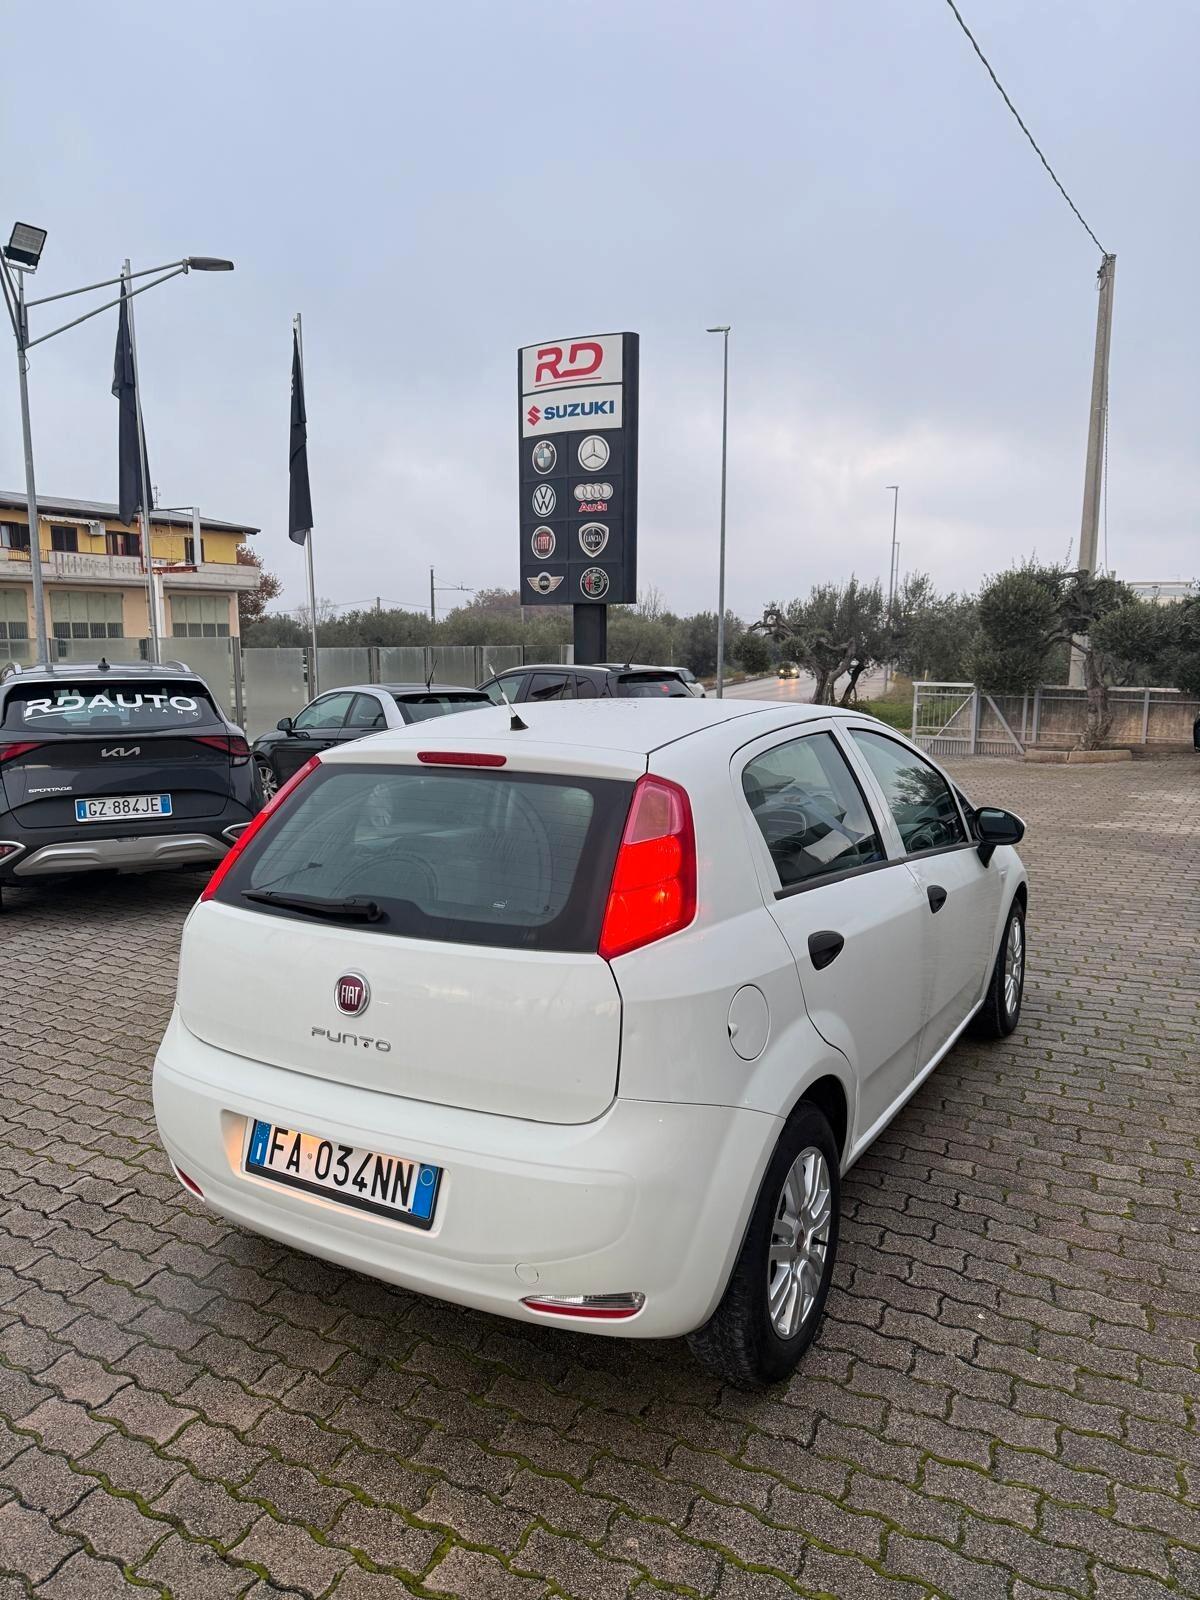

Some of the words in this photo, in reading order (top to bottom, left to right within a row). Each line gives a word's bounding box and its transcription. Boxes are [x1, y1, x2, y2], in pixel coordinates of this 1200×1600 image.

[535, 342, 604, 383] RD
[544, 400, 615, 420] SUZUKI
[535, 443, 554, 454] BMW
[578, 501, 608, 512] Audi
[537, 536, 549, 550] FIAT
[101, 746, 140, 757] KIA
[340, 984, 361, 1005] FIAT
[311, 1026, 392, 1052] PUNTO
